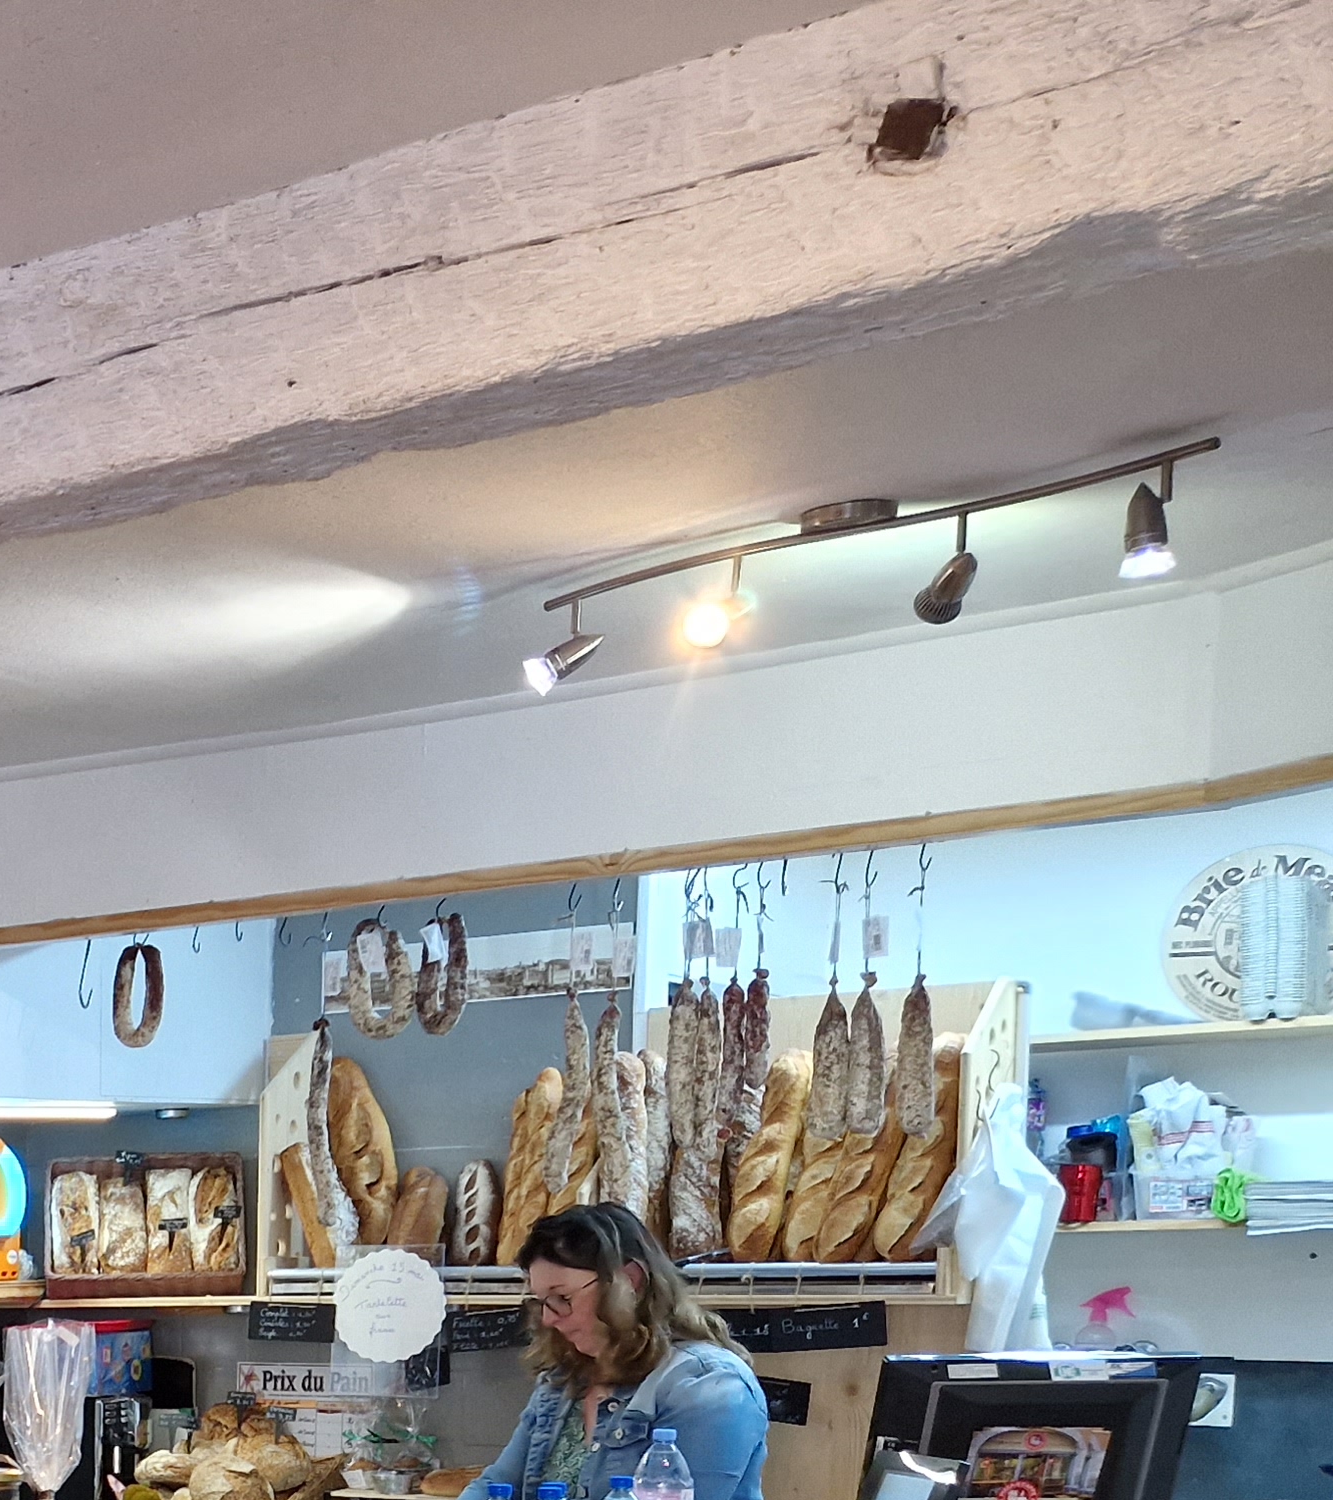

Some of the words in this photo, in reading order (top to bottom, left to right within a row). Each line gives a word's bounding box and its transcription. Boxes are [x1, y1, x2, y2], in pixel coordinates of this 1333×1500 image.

[1174, 866, 1246, 933] Brie
[781, 1317, 840, 1340] Baguette
[262, 1370, 297, 1391] Prix
[301, 1369, 324, 1392] du
[331, 1372, 370, 1393] Pain
